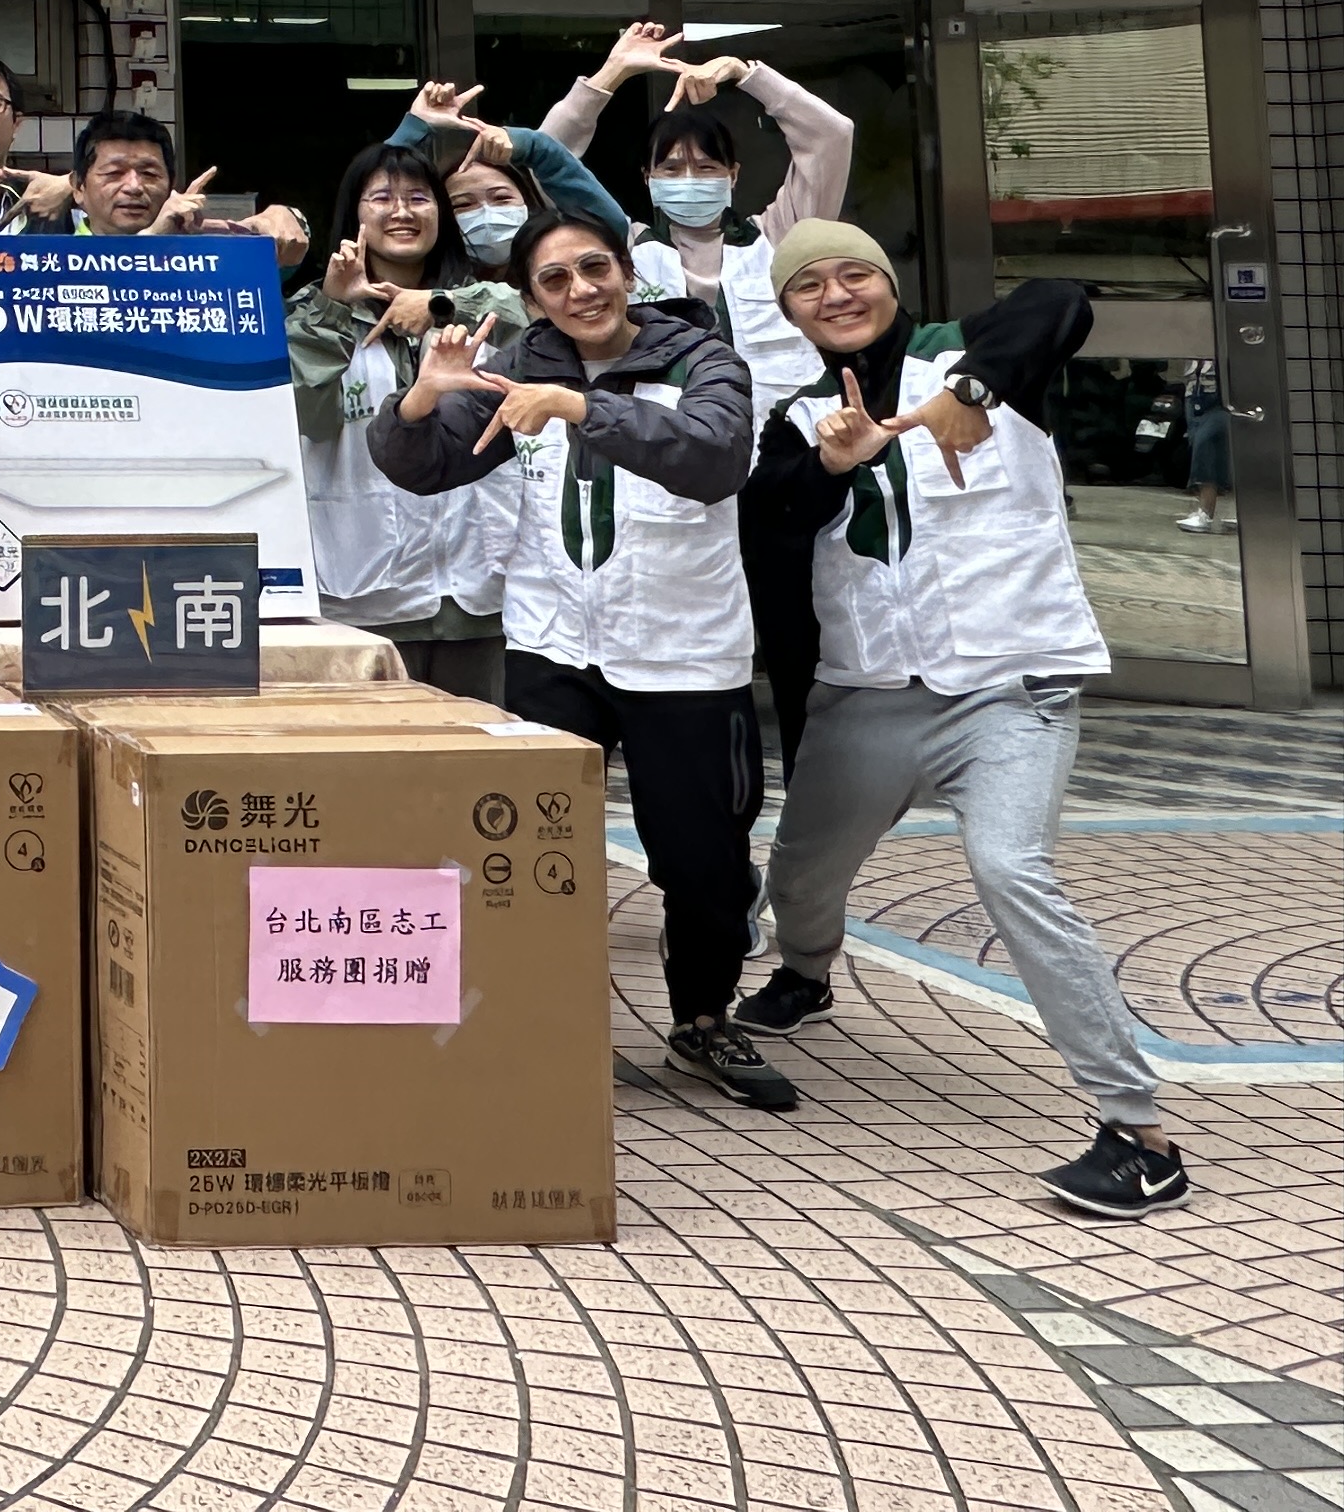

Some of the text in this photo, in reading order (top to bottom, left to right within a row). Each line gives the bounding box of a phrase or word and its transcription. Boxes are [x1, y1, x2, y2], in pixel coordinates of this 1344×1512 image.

[237, 290, 259, 334] 白光
[41, 574, 244, 650] 北 南
[240, 792, 319, 830] 舞光
[265, 908, 448, 936] 台北南區志工
[277, 957, 431, 985] 服務團捐贈
